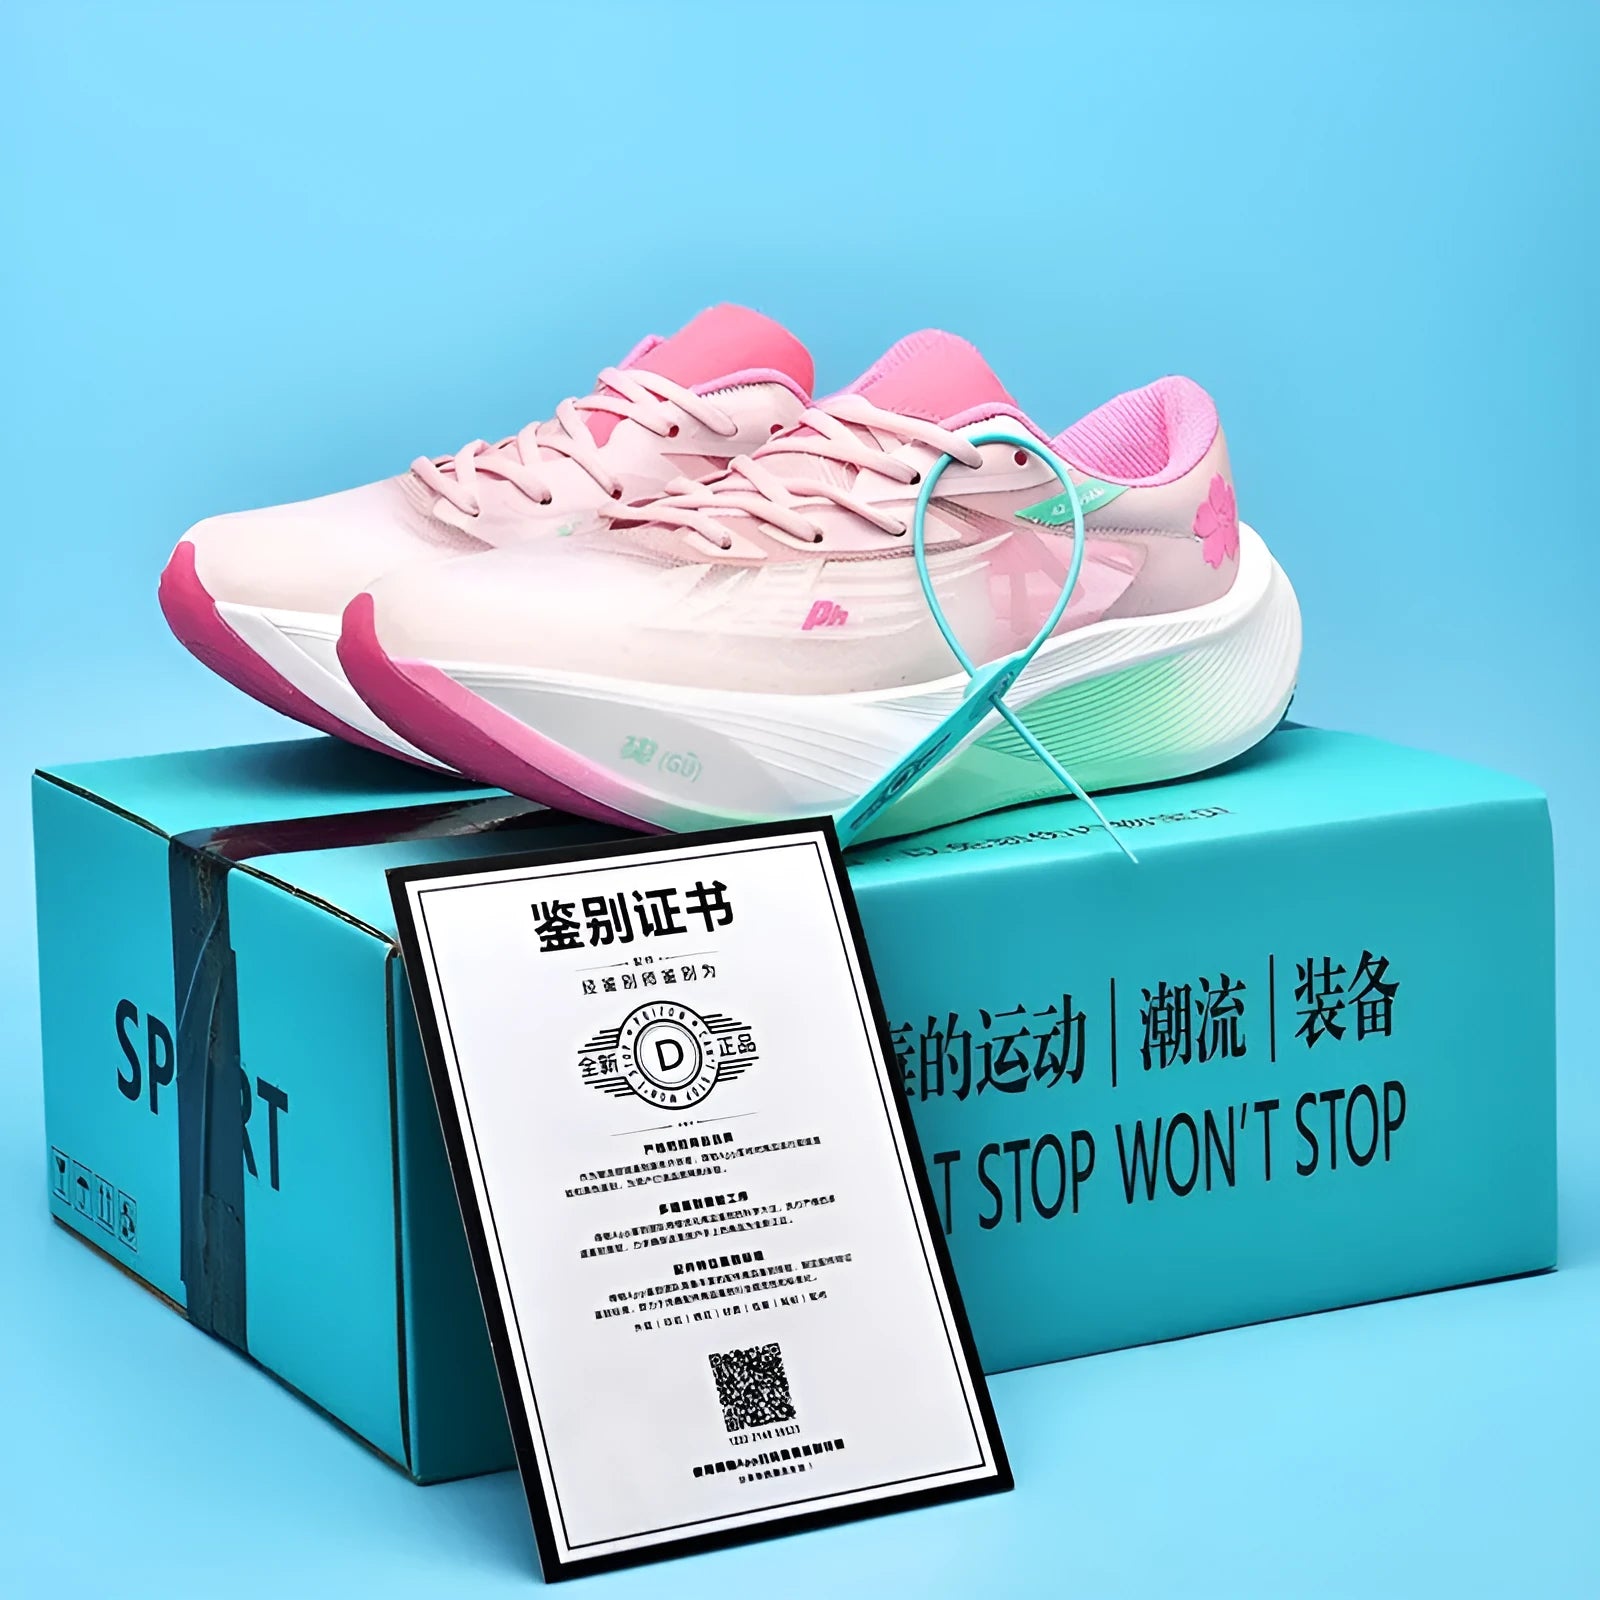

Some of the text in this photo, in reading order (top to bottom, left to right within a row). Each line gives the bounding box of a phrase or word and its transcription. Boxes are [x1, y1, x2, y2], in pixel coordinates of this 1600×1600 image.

[531, 880, 734, 953] 鉴别证书
[717, 1033, 757, 1057] 正品
[1139, 972, 1247, 1072] 潮流
[1294, 949, 1400, 1049] 装备
[578, 1052, 619, 1078] 全新
[655, 1038, 684, 1072] D
[115, 998, 289, 1192] SPRT
[977, 1129, 1096, 1230] STOP
[1114, 1098, 1280, 1205] WON'T
[1295, 1080, 1407, 1177] STOP
